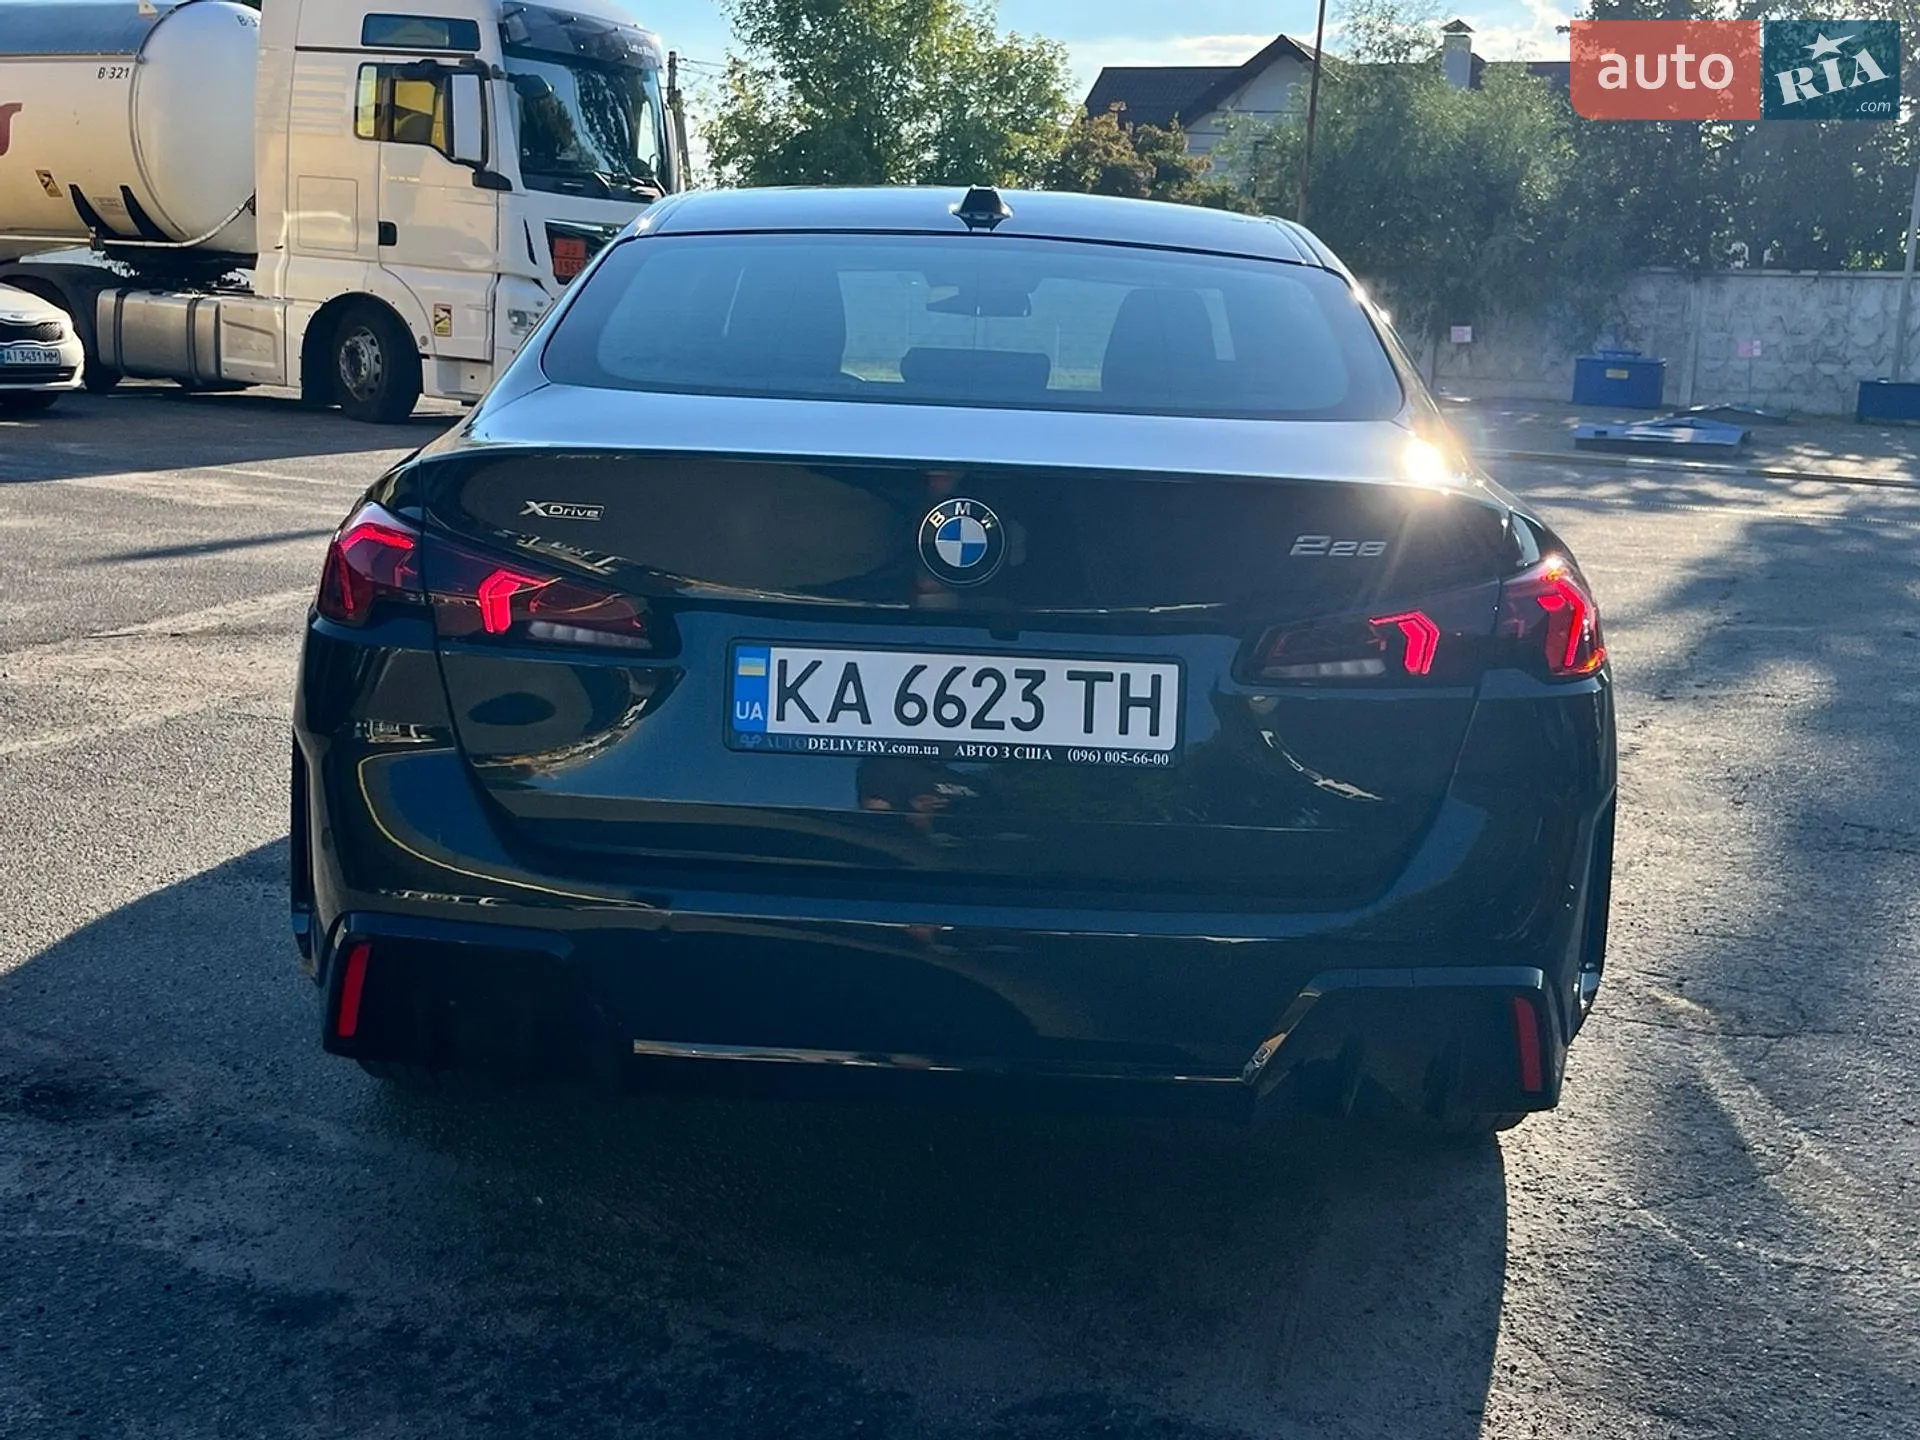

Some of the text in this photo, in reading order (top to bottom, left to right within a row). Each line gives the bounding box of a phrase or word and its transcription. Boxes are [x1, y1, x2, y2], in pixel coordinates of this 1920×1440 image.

[928, 501, 997, 530] BMW
[1290, 535, 1387, 556] 228
[775, 658, 1163, 738] KA 6623 TH
[736, 700, 764, 721] UA
[954, 744, 999, 759] АВТО
[1013, 747, 1053, 761] США
[1066, 748, 1102, 764] (096)
[1103, 750, 1170, 767] 005-66-00
